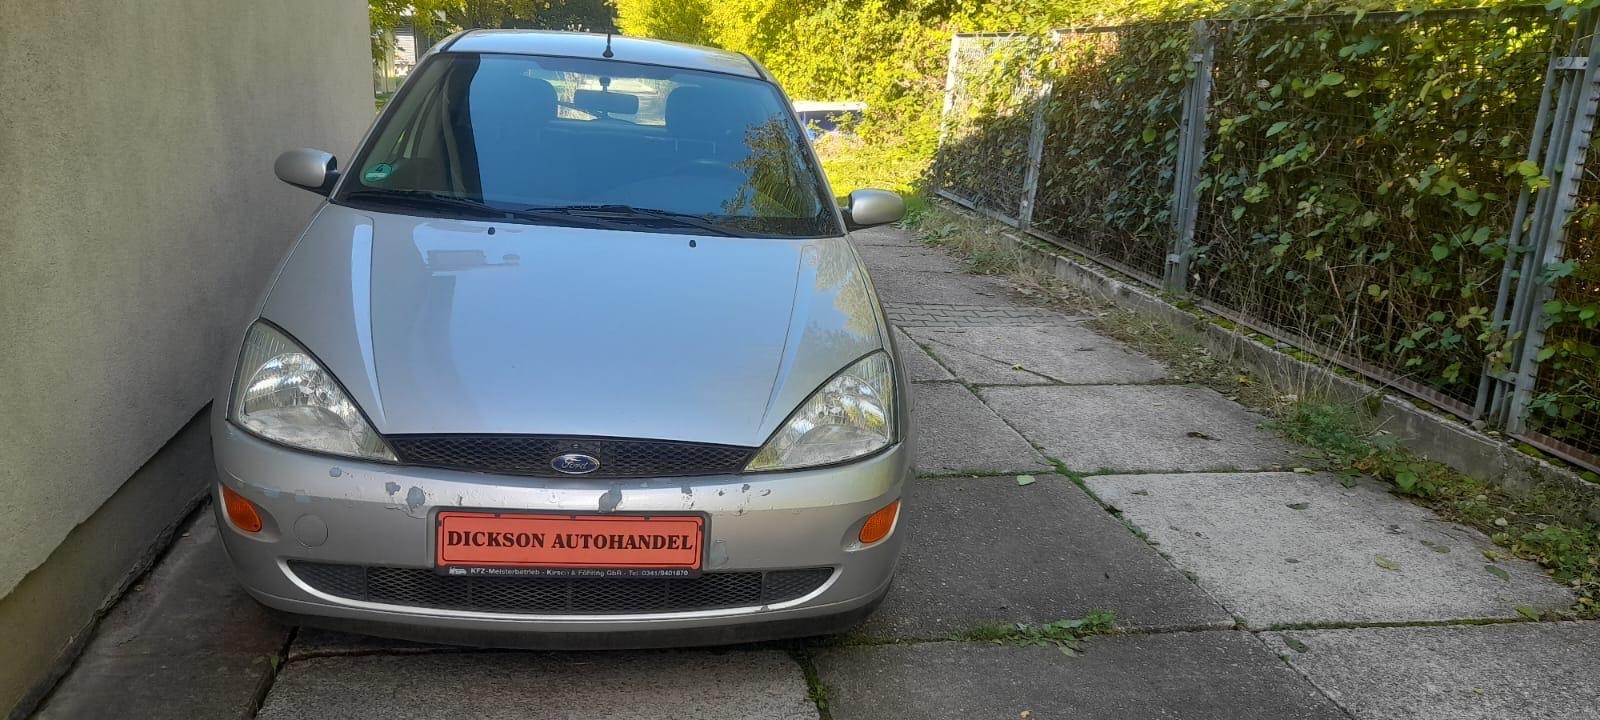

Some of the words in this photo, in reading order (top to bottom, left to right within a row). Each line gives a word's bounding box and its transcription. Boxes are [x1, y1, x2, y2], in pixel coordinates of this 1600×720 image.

[562, 457, 588, 469] Ford
[448, 531, 545, 548] DICKSON
[551, 534, 693, 550] AUTOHANDEL
[470, 567, 540, 575] KFZ-Meisterbetrieb
